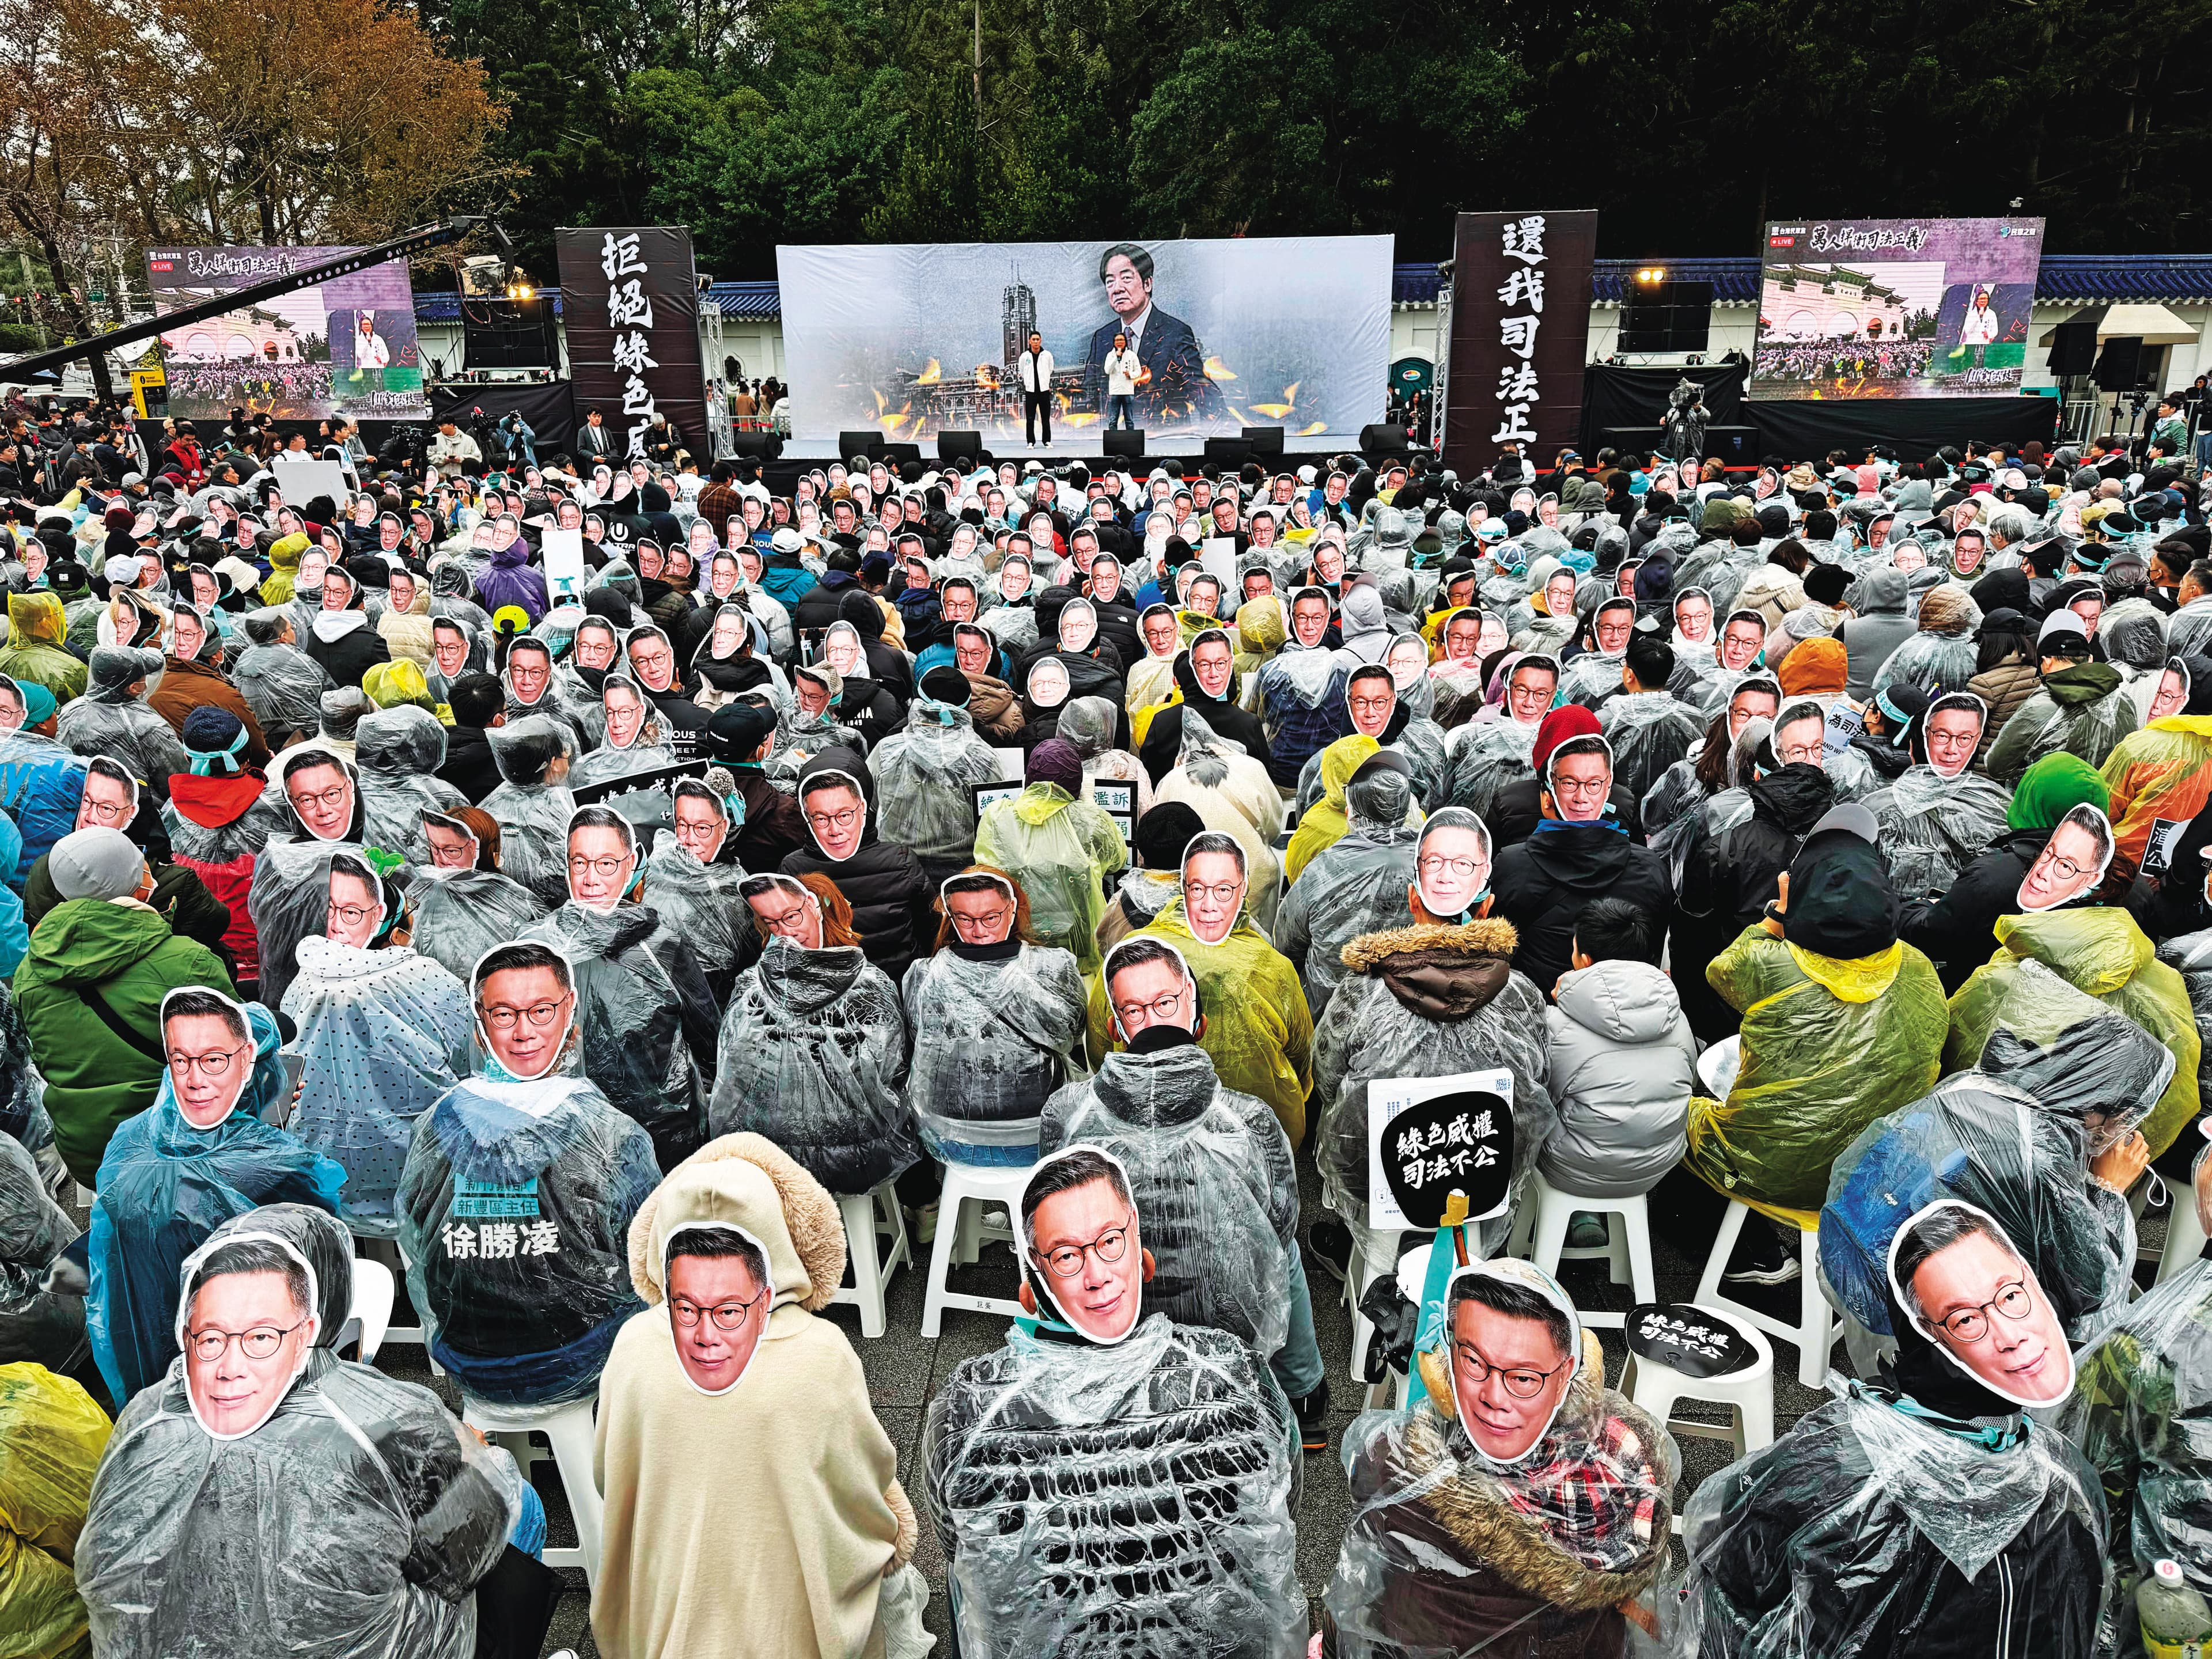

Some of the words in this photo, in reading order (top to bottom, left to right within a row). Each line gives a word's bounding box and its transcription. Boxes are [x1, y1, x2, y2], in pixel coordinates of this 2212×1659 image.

[1810, 225, 1927, 253] 萬人捍衛司法正義!
[1492, 215, 1549, 460] 還我司法正
[1822, 741, 1834, 751] AND
[1396, 1109, 1499, 1162] 綠色威權
[1402, 1145, 1500, 1190] 司法不公
[457, 1199, 536, 1215] 新豐區主任
[441, 1220, 561, 1259] 徐勝凌
[976, 1301, 992, 1309] 巨蛋
[1638, 1325, 1724, 1359] 司法不公
[1641, 1313, 1730, 1350] 綠色威權
